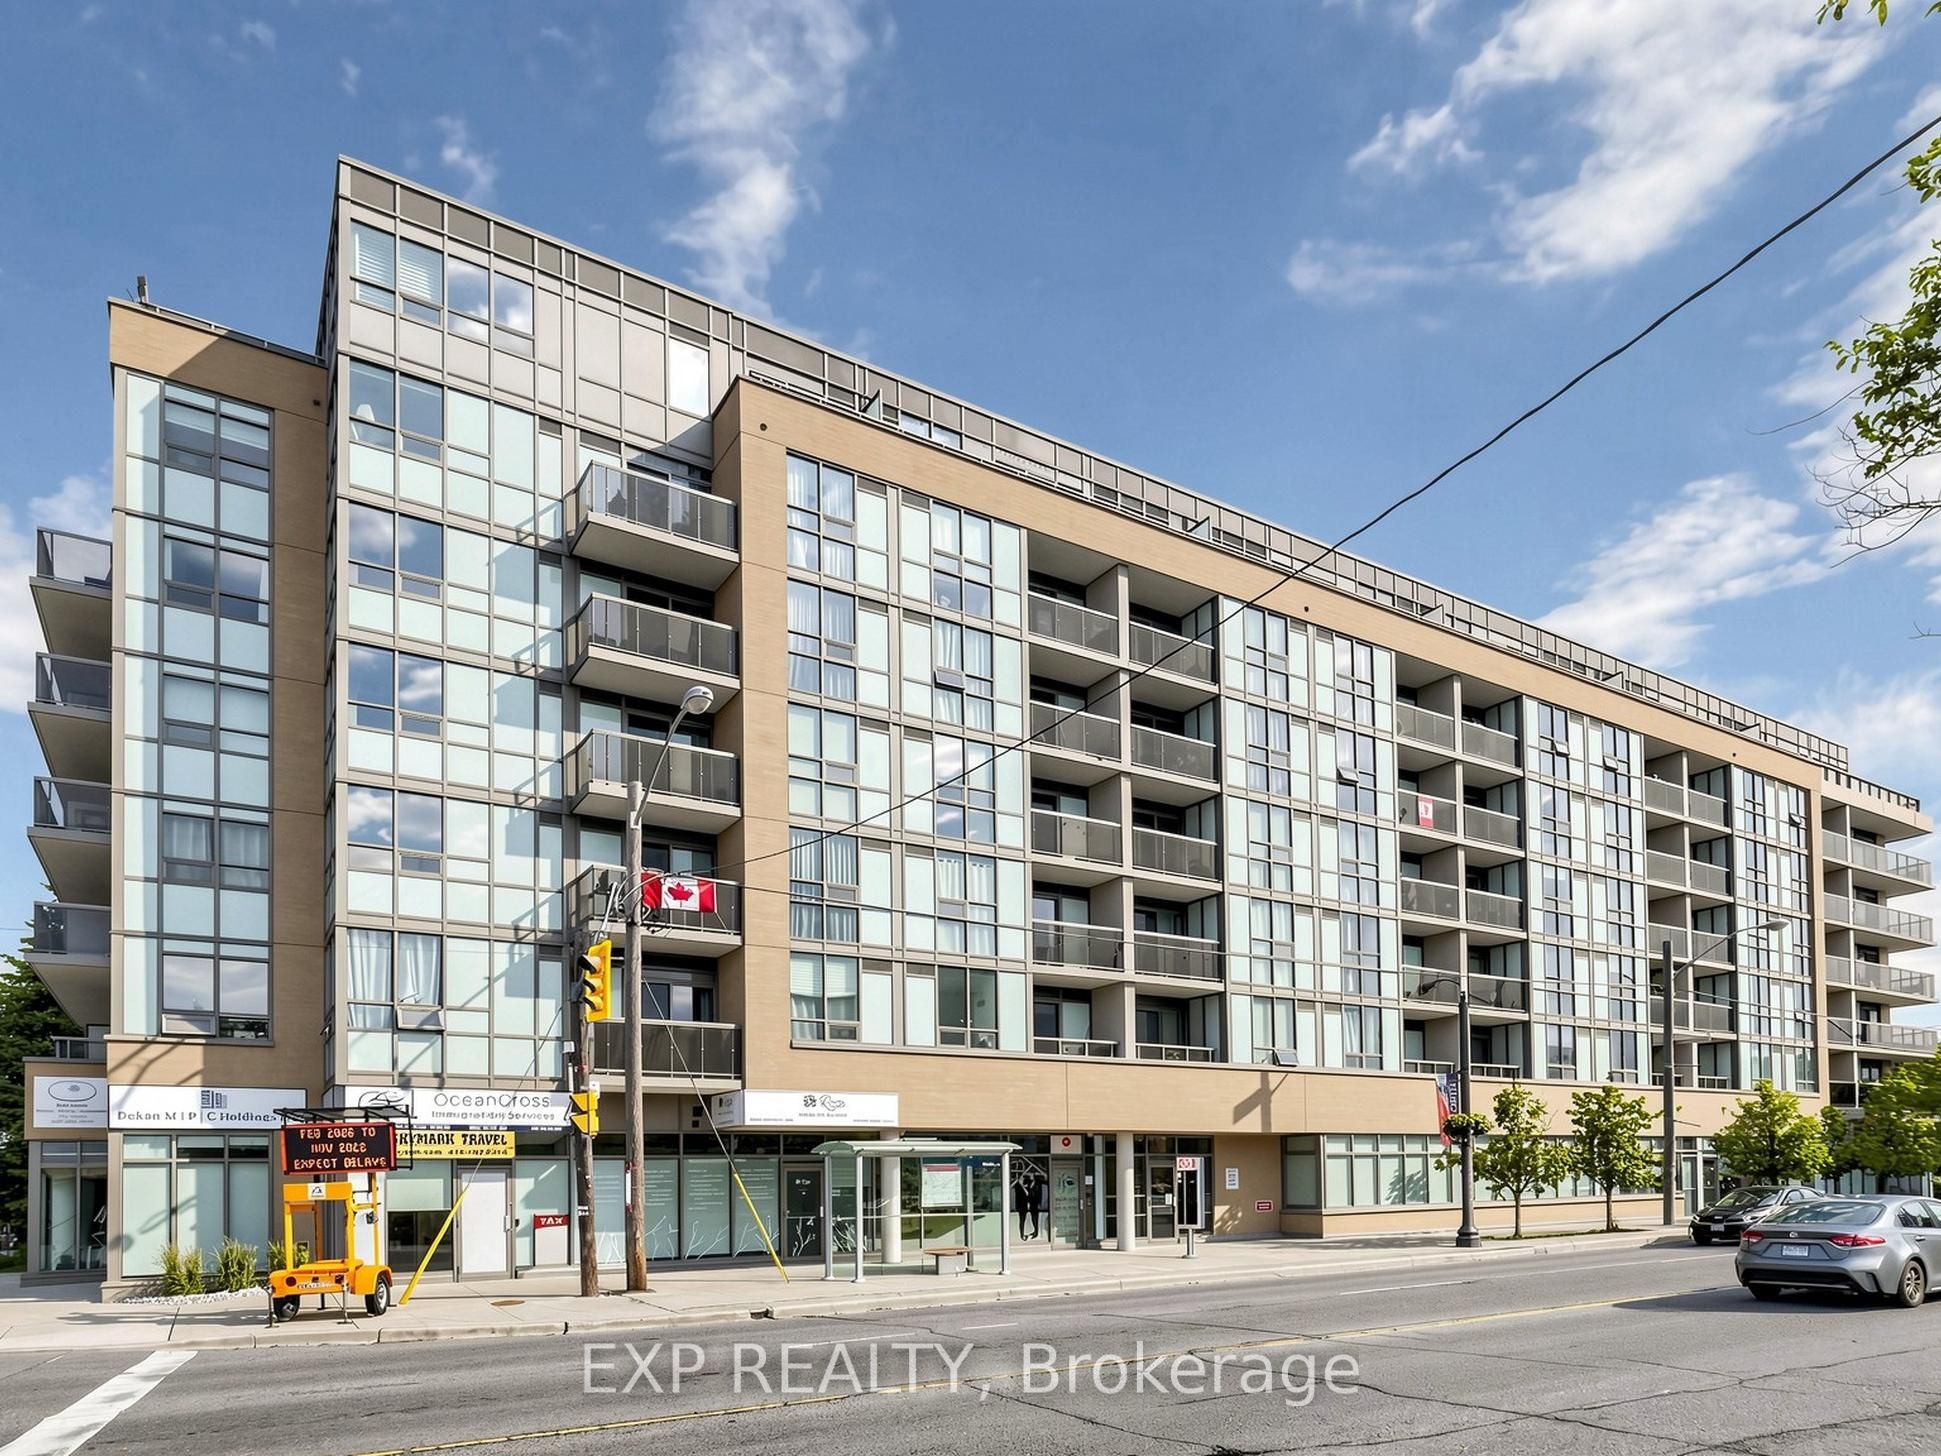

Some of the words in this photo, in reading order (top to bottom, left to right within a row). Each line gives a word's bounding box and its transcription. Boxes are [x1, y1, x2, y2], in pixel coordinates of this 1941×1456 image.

[433, 1092, 551, 1108] OceanCross
[117, 1111, 161, 1121] Dekan
[361, 1126, 377, 1137] TO
[461, 1133, 508, 1146] TRAVEL
[293, 1157, 338, 1170] EXPECT
[539, 1216, 564, 1226] TAX
